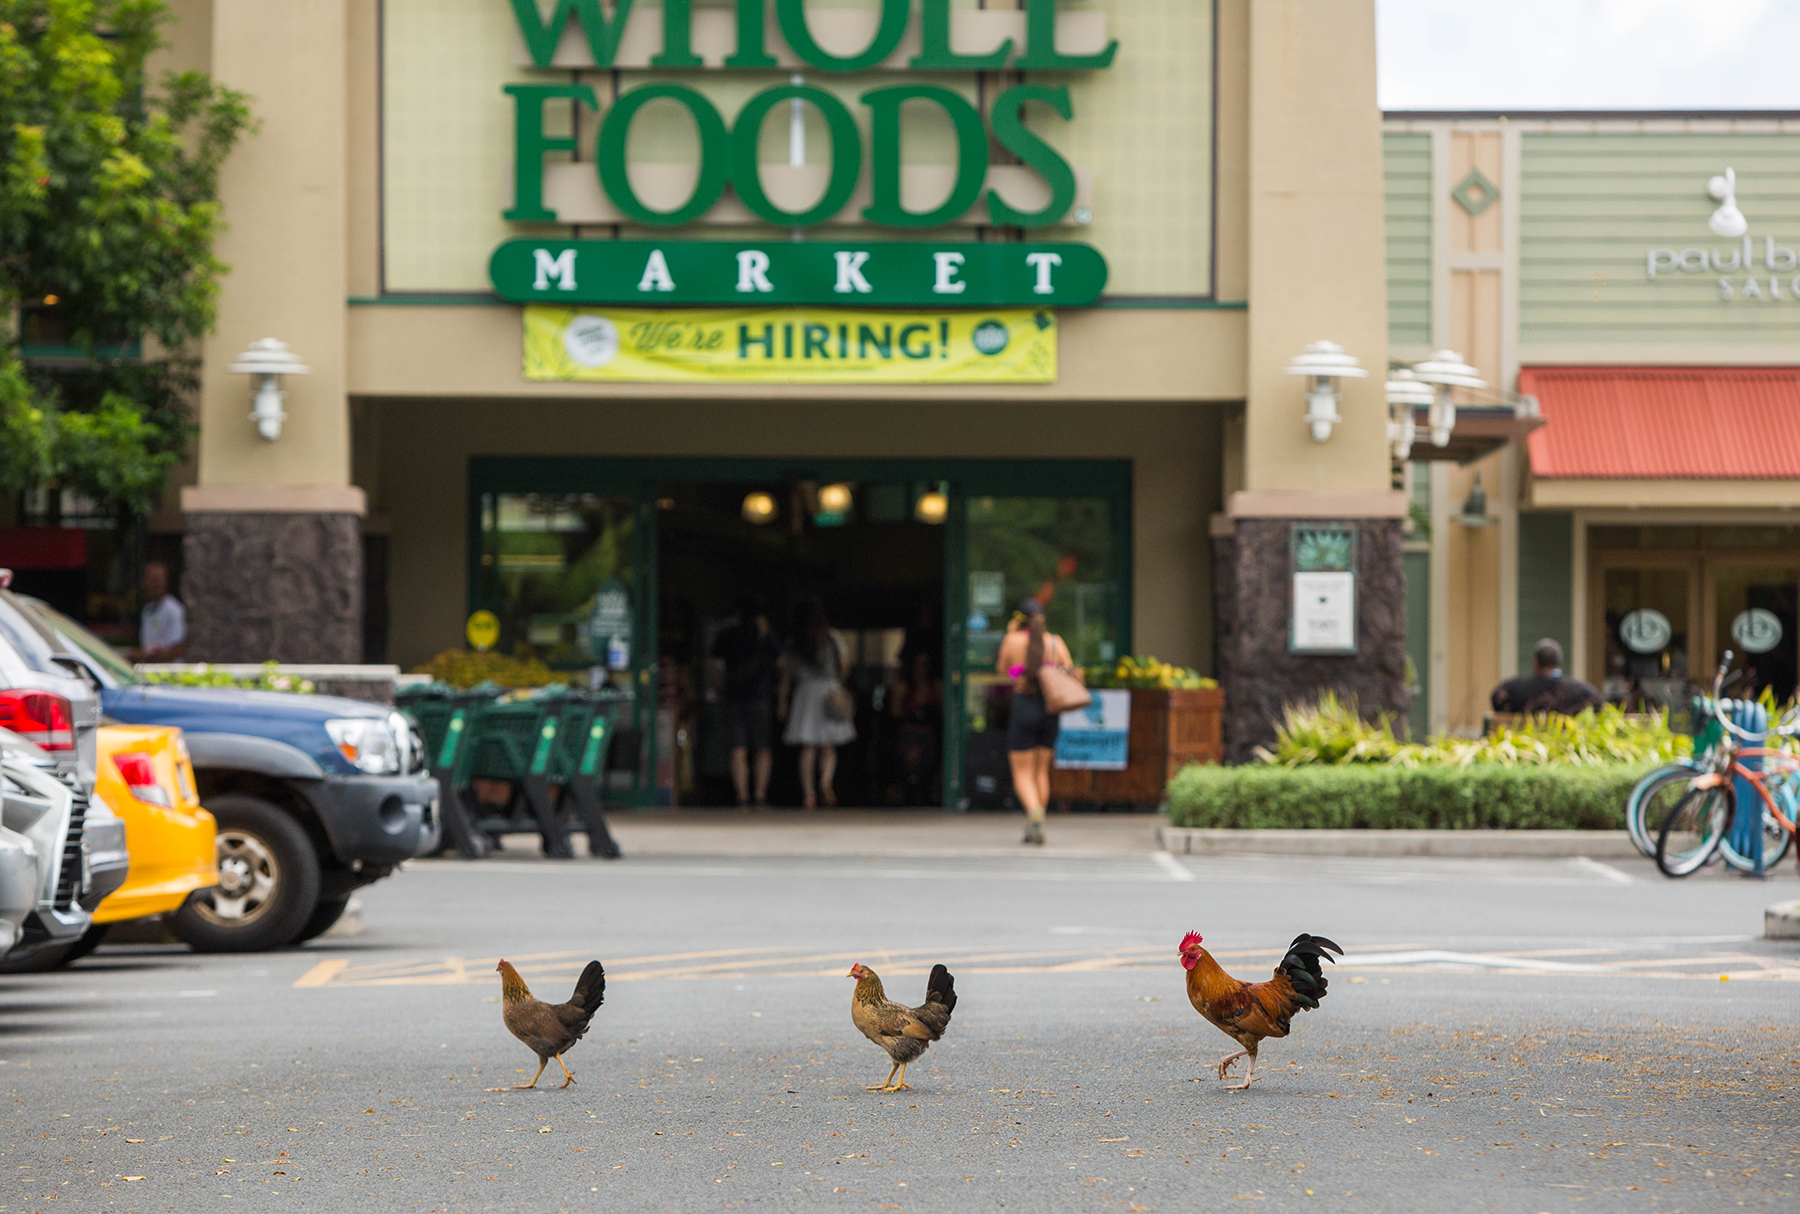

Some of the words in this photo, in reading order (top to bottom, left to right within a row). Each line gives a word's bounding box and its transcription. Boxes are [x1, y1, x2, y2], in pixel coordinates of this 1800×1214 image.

[502, 82, 1077, 227] FOODS
[532, 249, 1062, 293] MARKET
[1647, 235, 1752, 280] paul
[1765, 235, 1800, 273] b
[629, 320, 725, 351] We're
[738, 319, 949, 360] HIRING!
